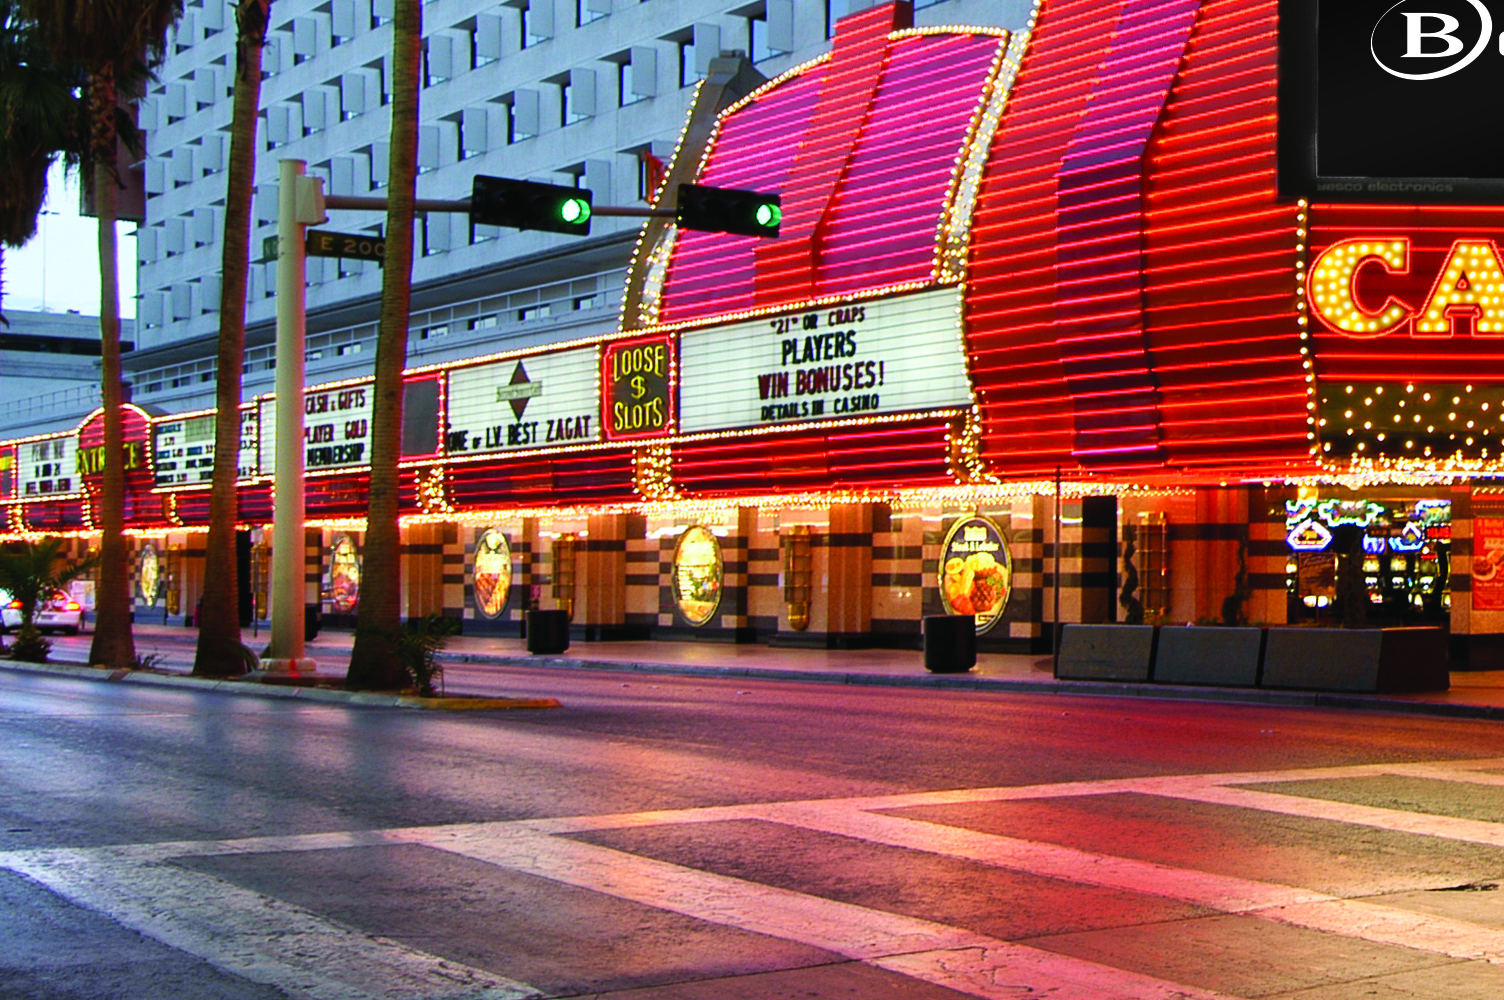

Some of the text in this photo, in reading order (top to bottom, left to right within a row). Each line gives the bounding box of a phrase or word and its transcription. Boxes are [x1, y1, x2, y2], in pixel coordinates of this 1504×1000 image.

[1367, 181, 1454, 193] electronics
[321, 236, 334, 251] E
[802, 313, 818, 330] OR
[828, 306, 866, 327] CRAPS
[781, 329, 857, 366] PLAYERS
[613, 345, 665, 382] LOOSE
[757, 360, 885, 400] WIN BONUSES!
[338, 389, 366, 411] GIFTS
[760, 393, 880, 421] DETAILS IN CASINO
[614, 397, 663, 431] SLOTS
[345, 419, 367, 440] GOLD
[507, 422, 538, 446] BEST
[546, 416, 591, 442] ZAGAT
[306, 443, 365, 467] MEMBERSHIP
